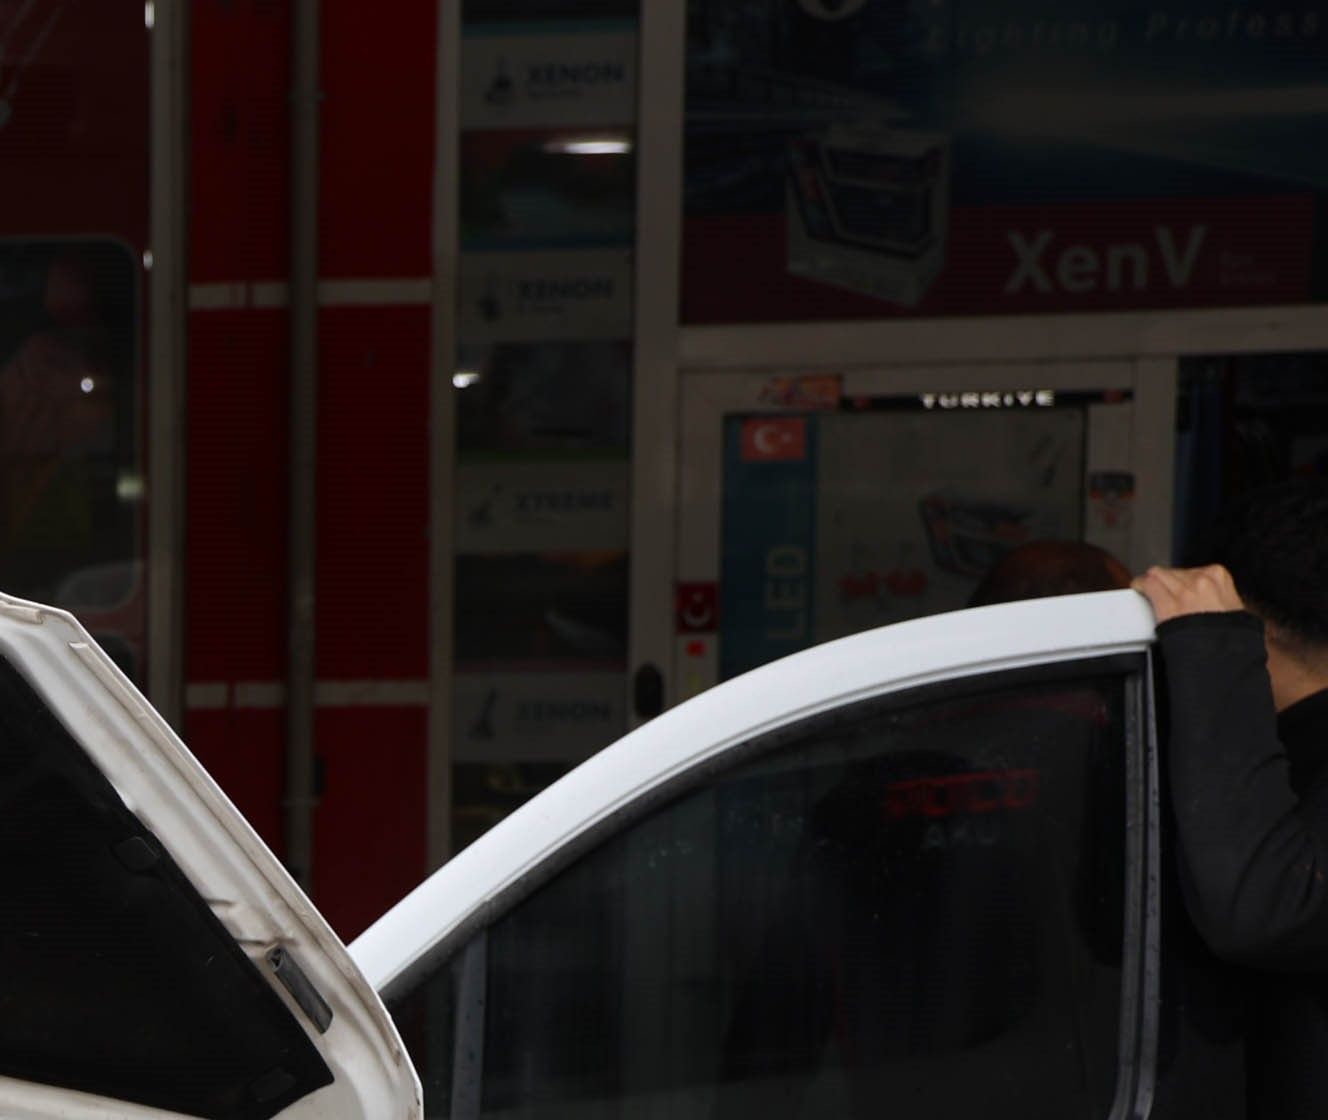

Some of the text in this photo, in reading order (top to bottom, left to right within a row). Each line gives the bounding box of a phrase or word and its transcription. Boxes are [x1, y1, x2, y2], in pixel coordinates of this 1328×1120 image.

[924, 16, 1120, 54] Lighting
[1001, 224, 1210, 296] XenV
[765, 545, 807, 641] LED
